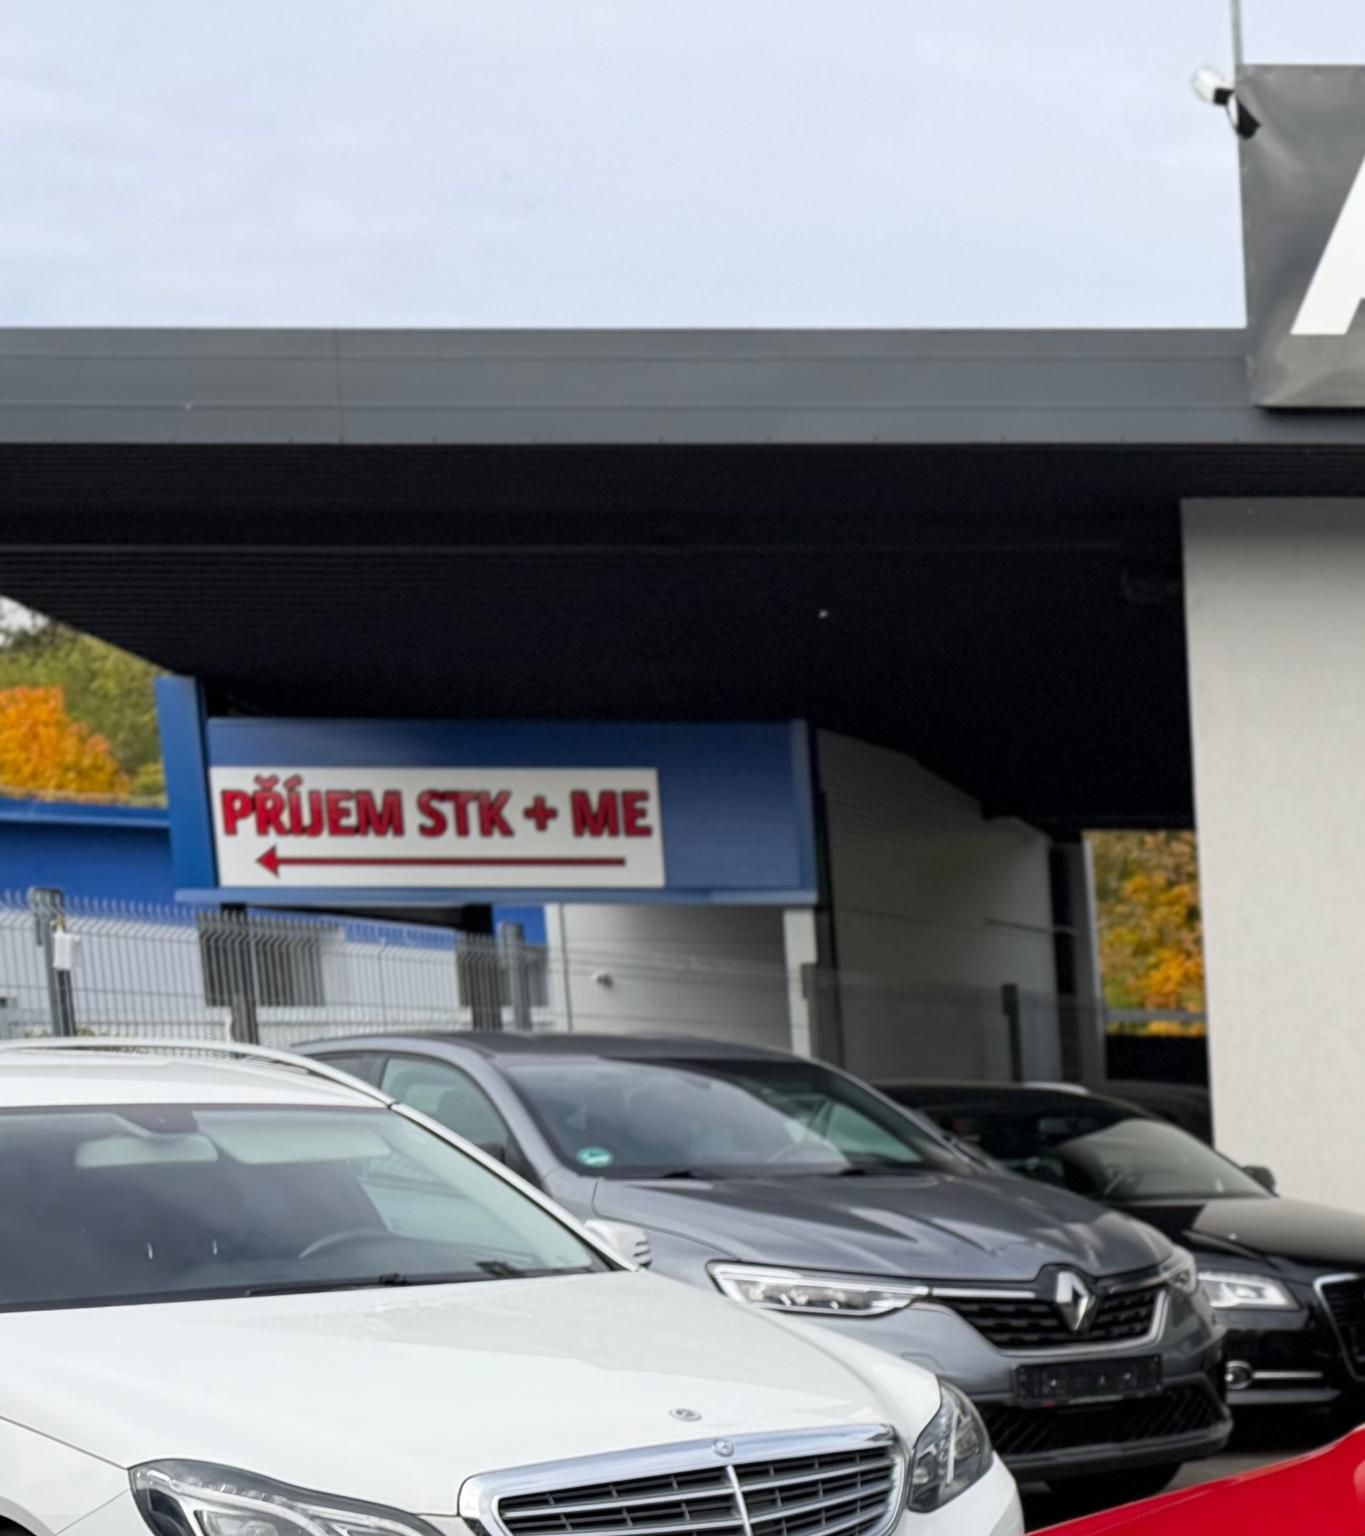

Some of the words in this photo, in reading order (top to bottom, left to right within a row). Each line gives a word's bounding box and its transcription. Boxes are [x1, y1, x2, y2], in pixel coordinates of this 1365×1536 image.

[220, 775, 404, 838] PŘÍJEM
[418, 790, 513, 838] STK
[571, 791, 652, 838] ME
